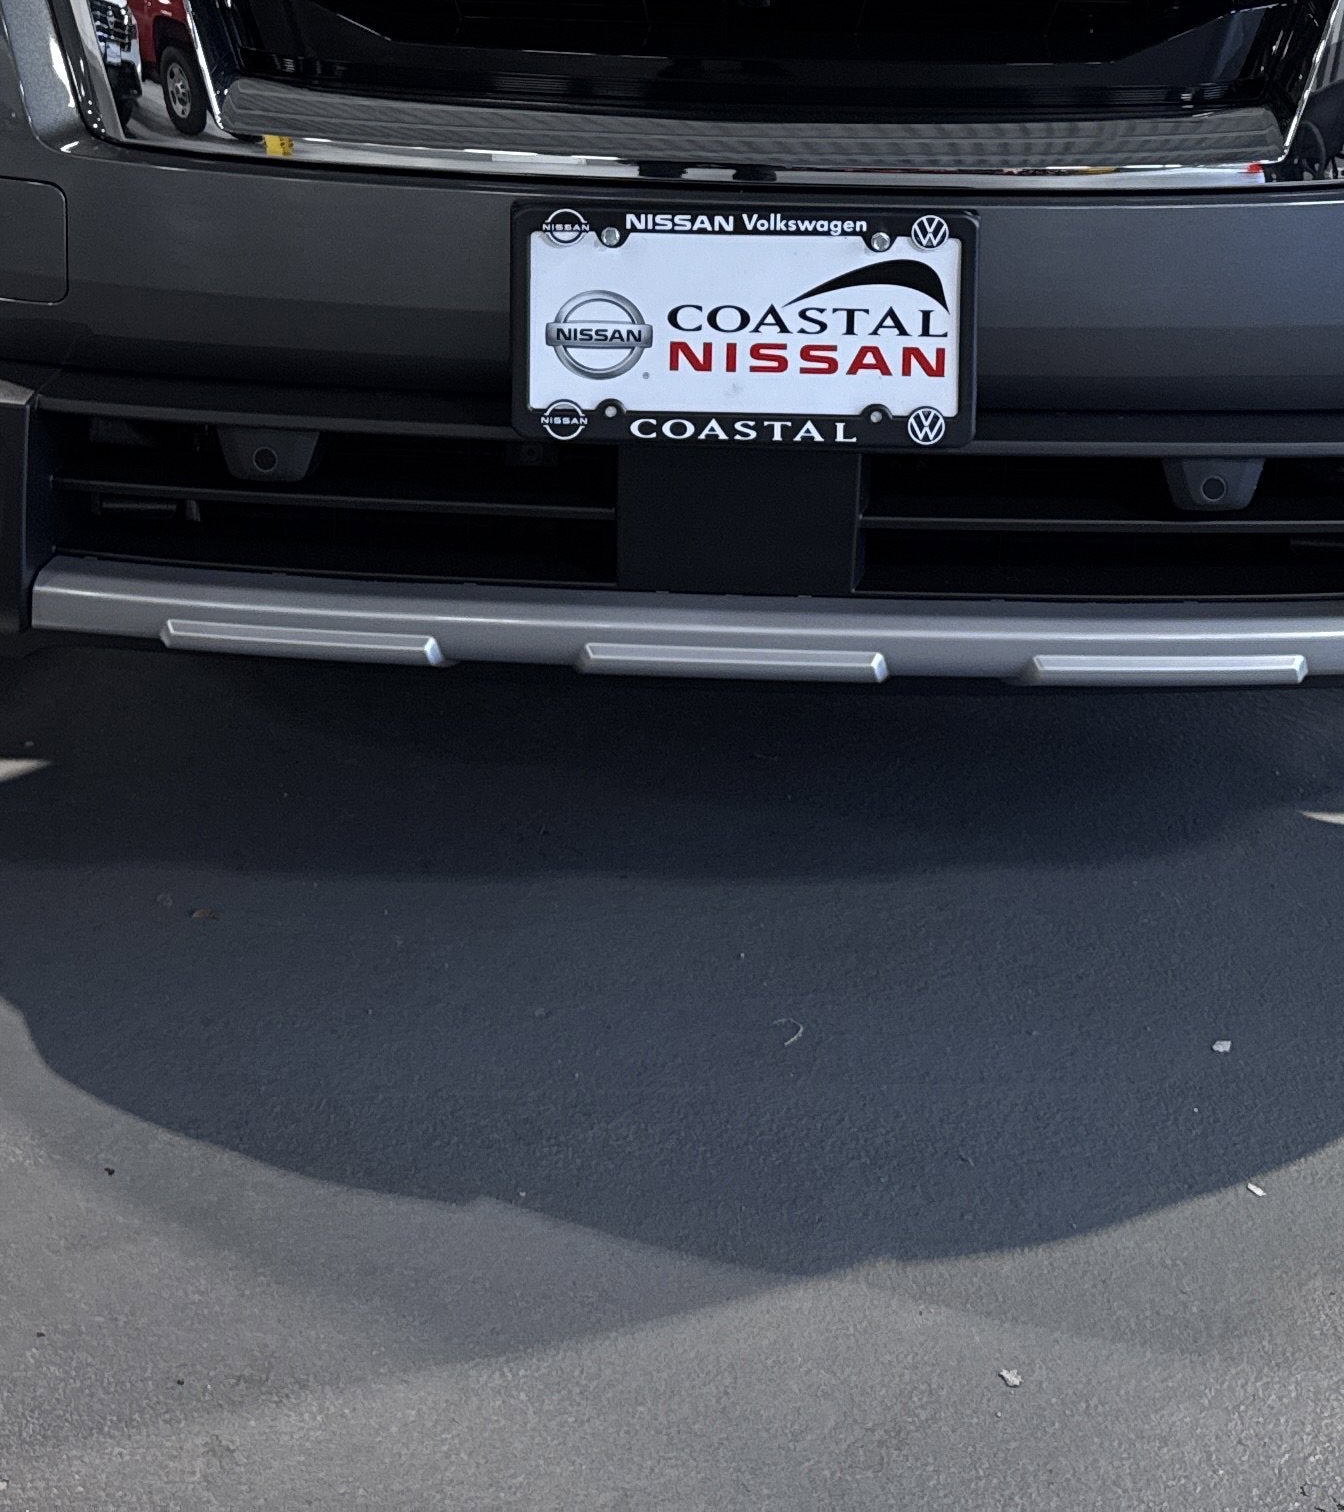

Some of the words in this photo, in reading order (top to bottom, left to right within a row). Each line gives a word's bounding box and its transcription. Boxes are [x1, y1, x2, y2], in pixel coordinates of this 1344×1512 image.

[542, 223, 590, 232] NISSAN
[626, 213, 734, 232] NISSAN
[742, 213, 867, 236] Volkswagen
[666, 303, 949, 338] COASTAL
[556, 327, 642, 343] NISSAN
[669, 341, 946, 378] NISSAN
[540, 416, 588, 425] NISSAN
[629, 417, 858, 443] COASTAL
